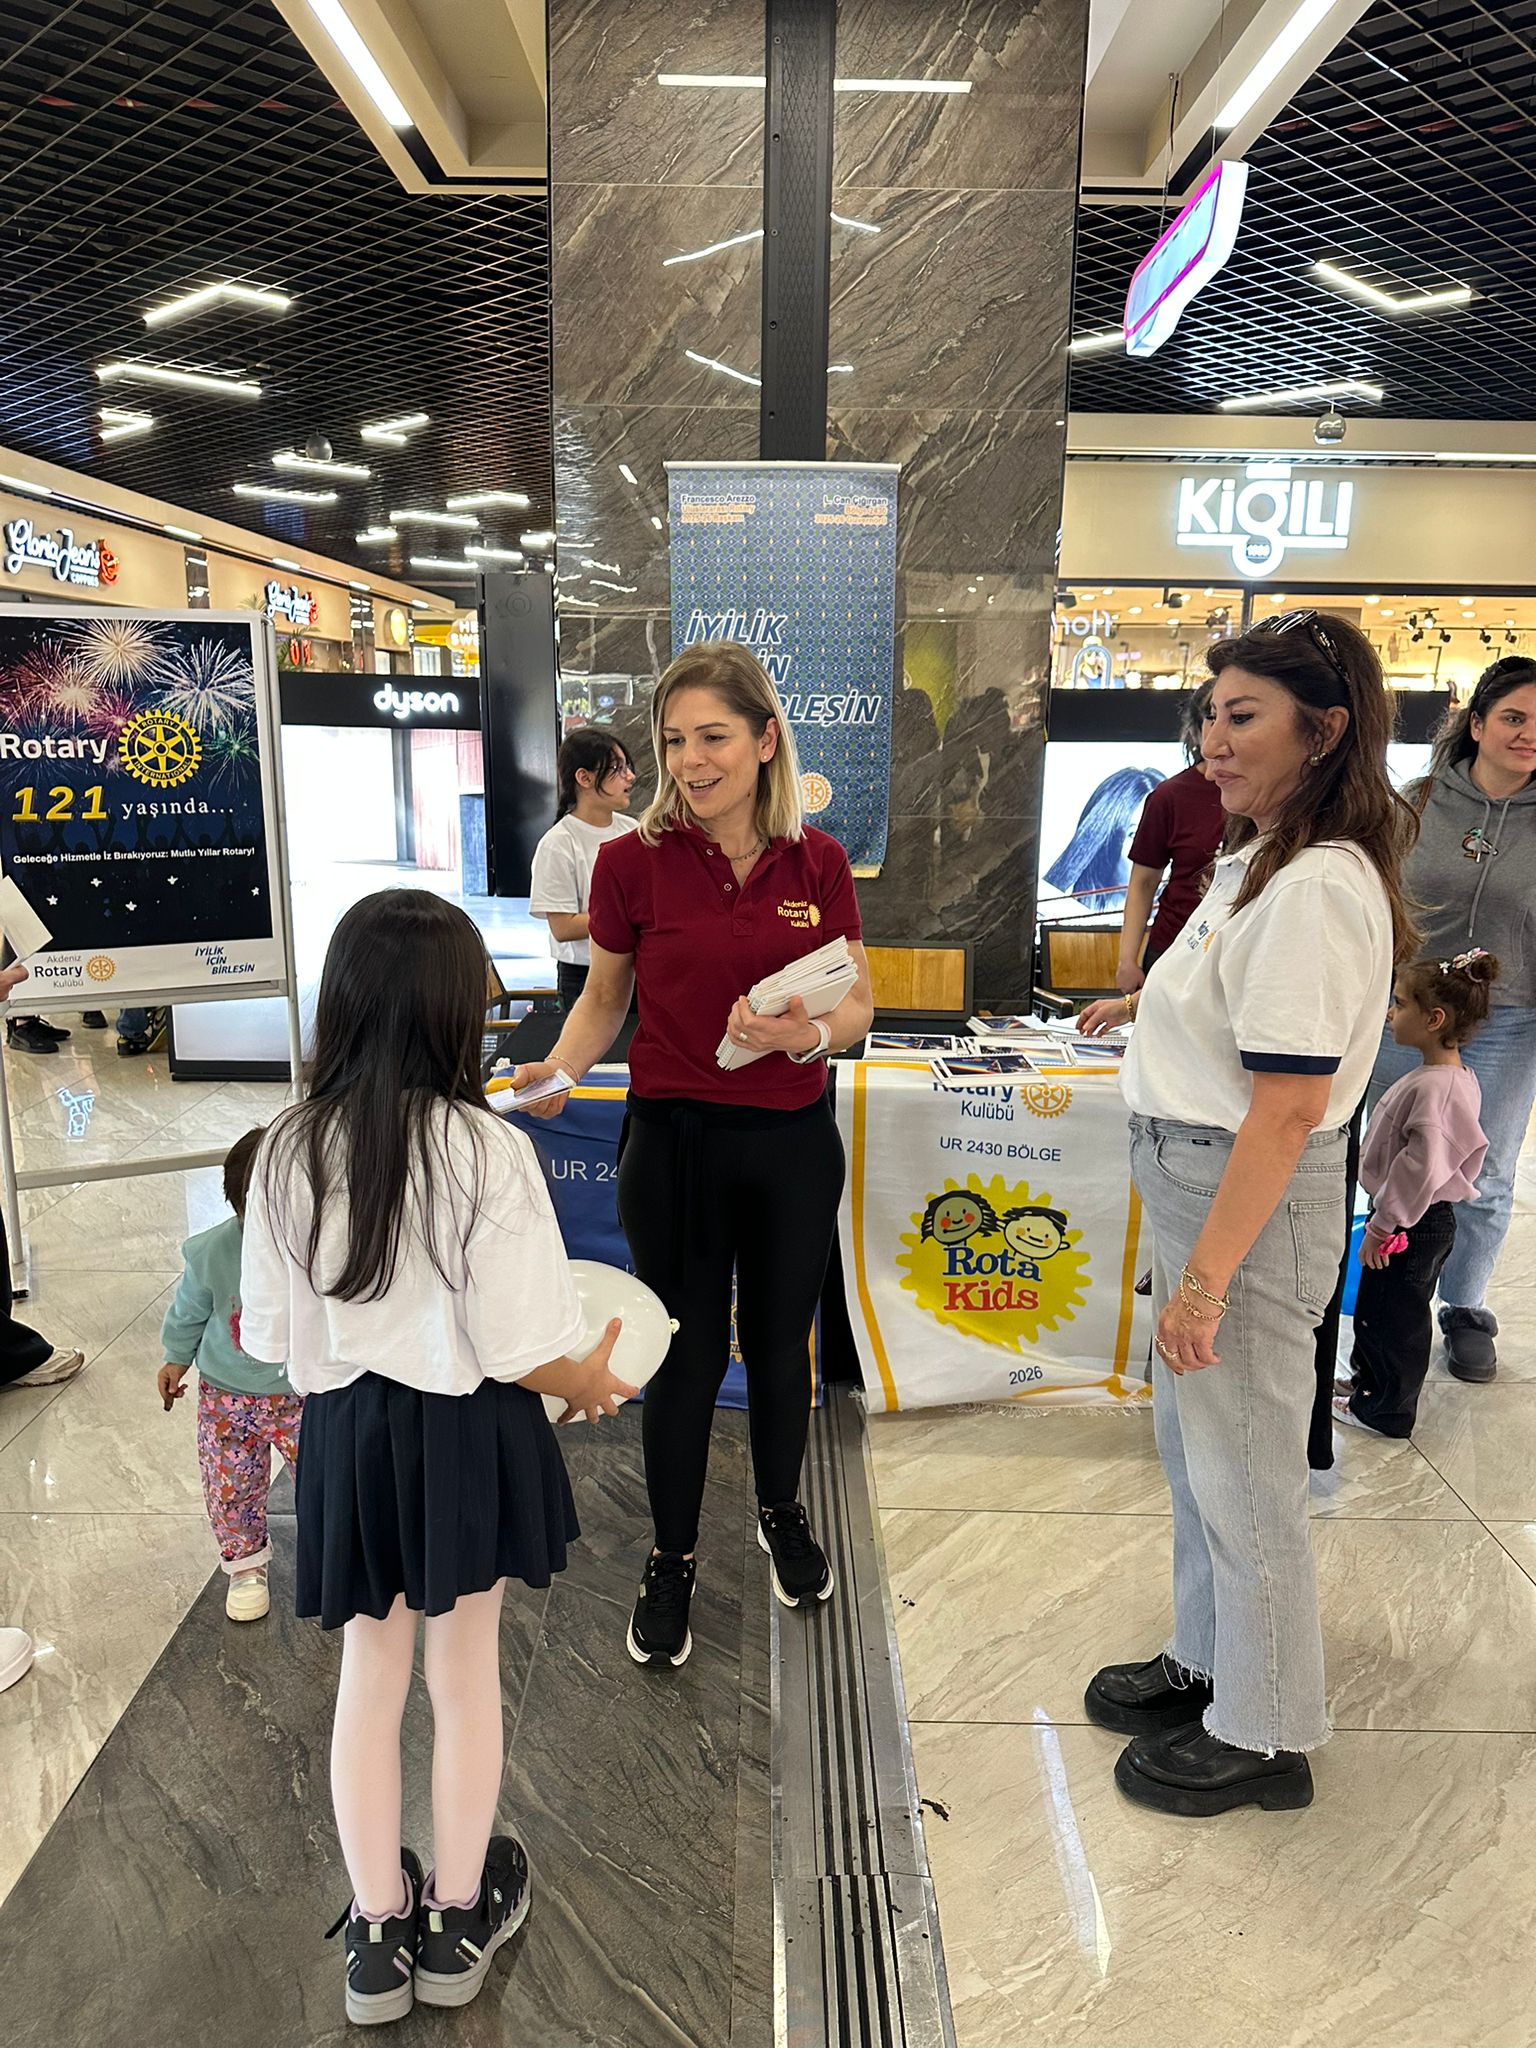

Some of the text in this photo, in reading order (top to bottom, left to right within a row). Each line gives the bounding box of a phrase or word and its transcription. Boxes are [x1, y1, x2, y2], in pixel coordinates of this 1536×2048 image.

[681, 494, 756, 504] Francesco Arezzo
[834, 496, 851, 505] Can
[8, 518, 100, 581] Gloria Jean's
[685, 608, 788, 645] İYİLİK
[373, 682, 460, 719] dyson
[141, 718, 176, 728] ROTARY
[0, 733, 108, 763] Rotary
[133, 759, 191, 779] INTERNATIONAL
[12, 785, 108, 822] 121
[13, 853, 59, 864] Geleceğe
[60, 852, 101, 862] Hizmetle
[113, 850, 169, 861] Bırakıyoruz:
[170, 848, 196, 858] Mutlu
[198, 847, 221, 857] Yıllar
[222, 846, 256, 857] Rotary!
[777, 905, 809, 920] Rotary
[46, 955, 82, 963] Akdeniz
[195, 945, 225, 956] İYİLİK
[34, 965, 83, 978] Rotary
[53, 979, 84, 989] Kulübü
[961, 1100, 1015, 1121] Kulübü
[940, 1136, 1062, 1162] UR 2430 BÖLGE
[552, 1159, 588, 1181] UR
[942, 1246, 1043, 1282] Rota
[943, 1279, 1039, 1311] Kids
[1008, 1365, 1043, 1385] 2026
